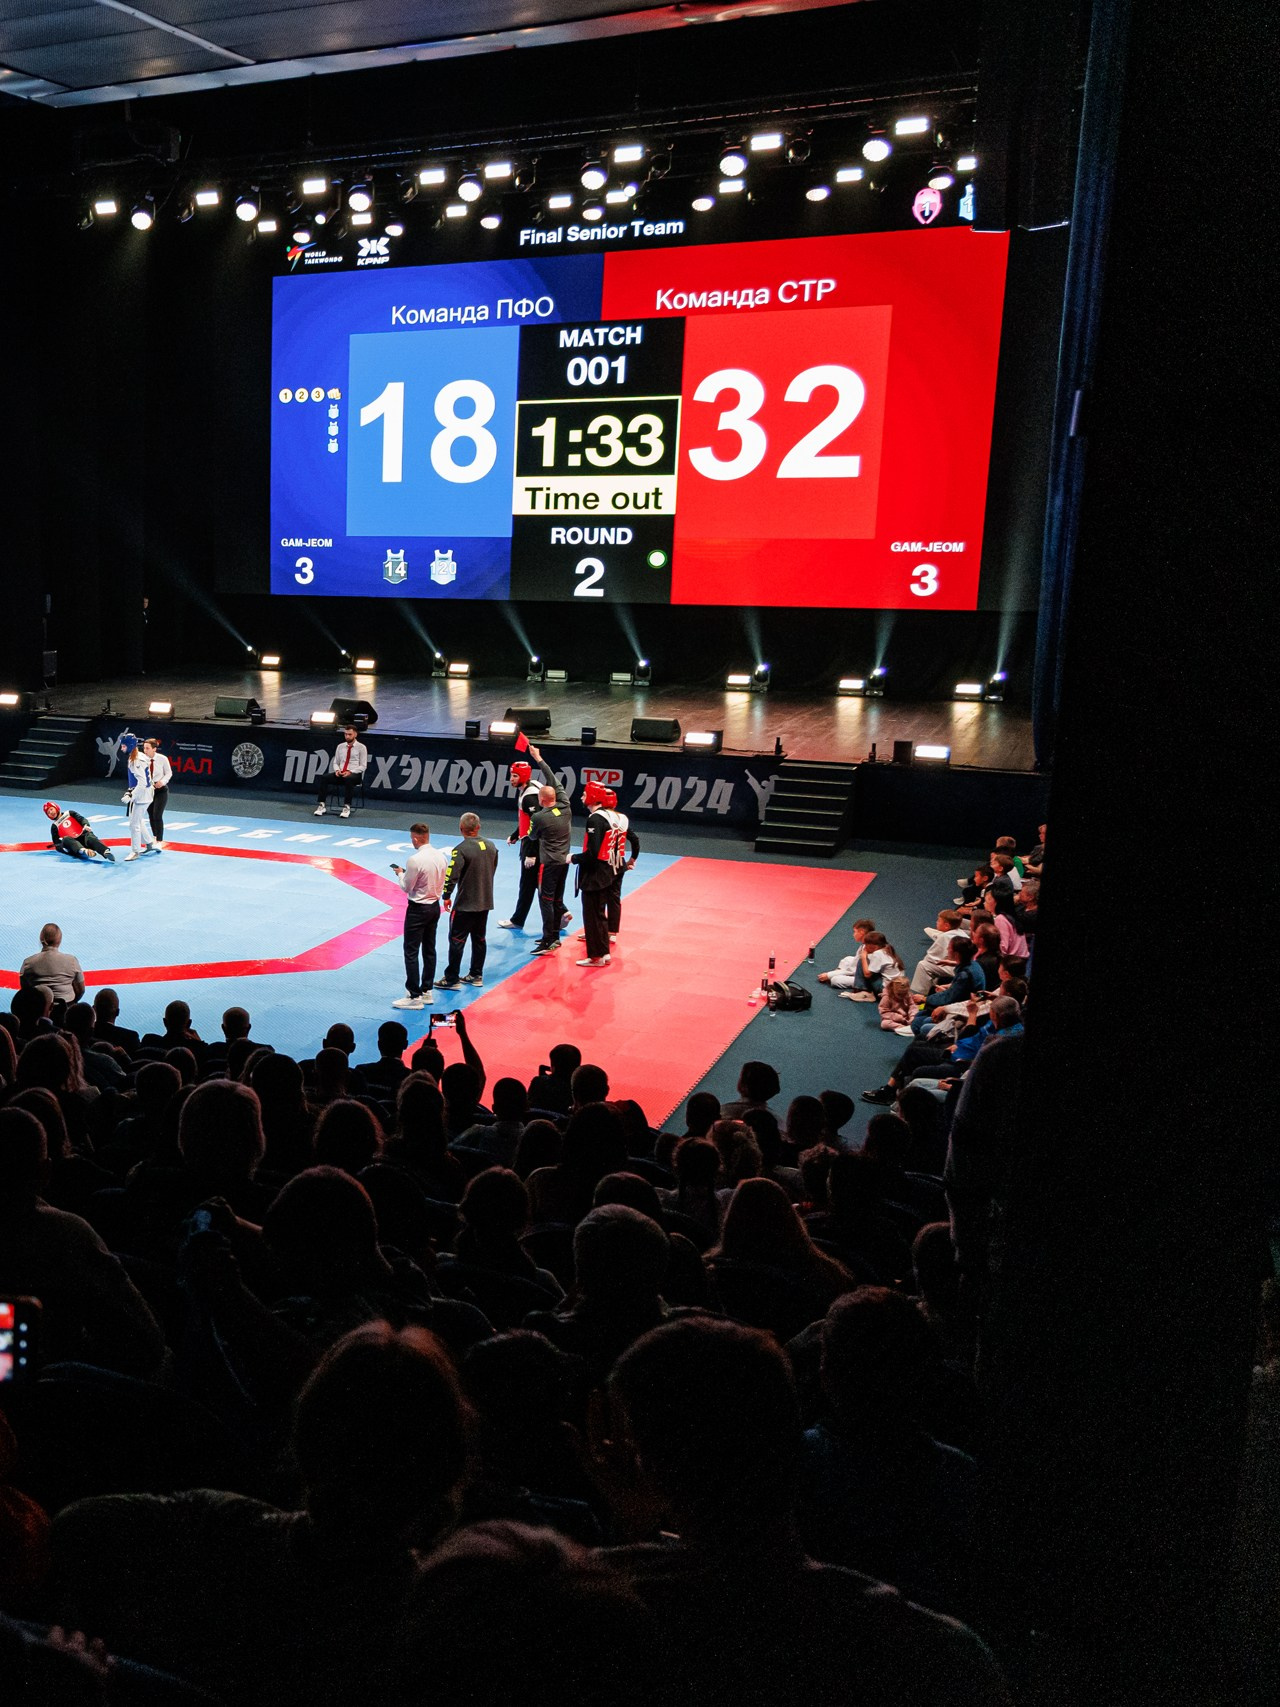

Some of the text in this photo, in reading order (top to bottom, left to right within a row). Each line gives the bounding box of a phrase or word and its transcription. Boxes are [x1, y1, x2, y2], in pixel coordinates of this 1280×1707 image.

[519, 219, 684, 246] Final Senior Team
[304, 250, 327, 258] WORLD
[304, 256, 343, 265] TAEKWONDO
[356, 256, 390, 266] KPNP
[656, 278, 836, 311] Команда СТР
[391, 296, 554, 325] Команда ПФО
[559, 326, 642, 348] MATCH
[566, 356, 627, 386] 001
[359, 379, 498, 484] 18
[688, 364, 867, 481] 32
[531, 414, 665, 468] 1:33
[524, 486, 663, 510] Time out
[280, 538, 333, 548] GAM-JEOM
[550, 526, 633, 545] ROUND
[890, 541, 964, 553] GAM-JEOM
[294, 556, 315, 585] 3
[384, 561, 407, 577] 14
[430, 561, 457, 575] 120
[573, 557, 605, 597] 2
[909, 563, 938, 597] 3
[583, 769, 621, 785] ТУР
[631, 772, 734, 815] 2024
